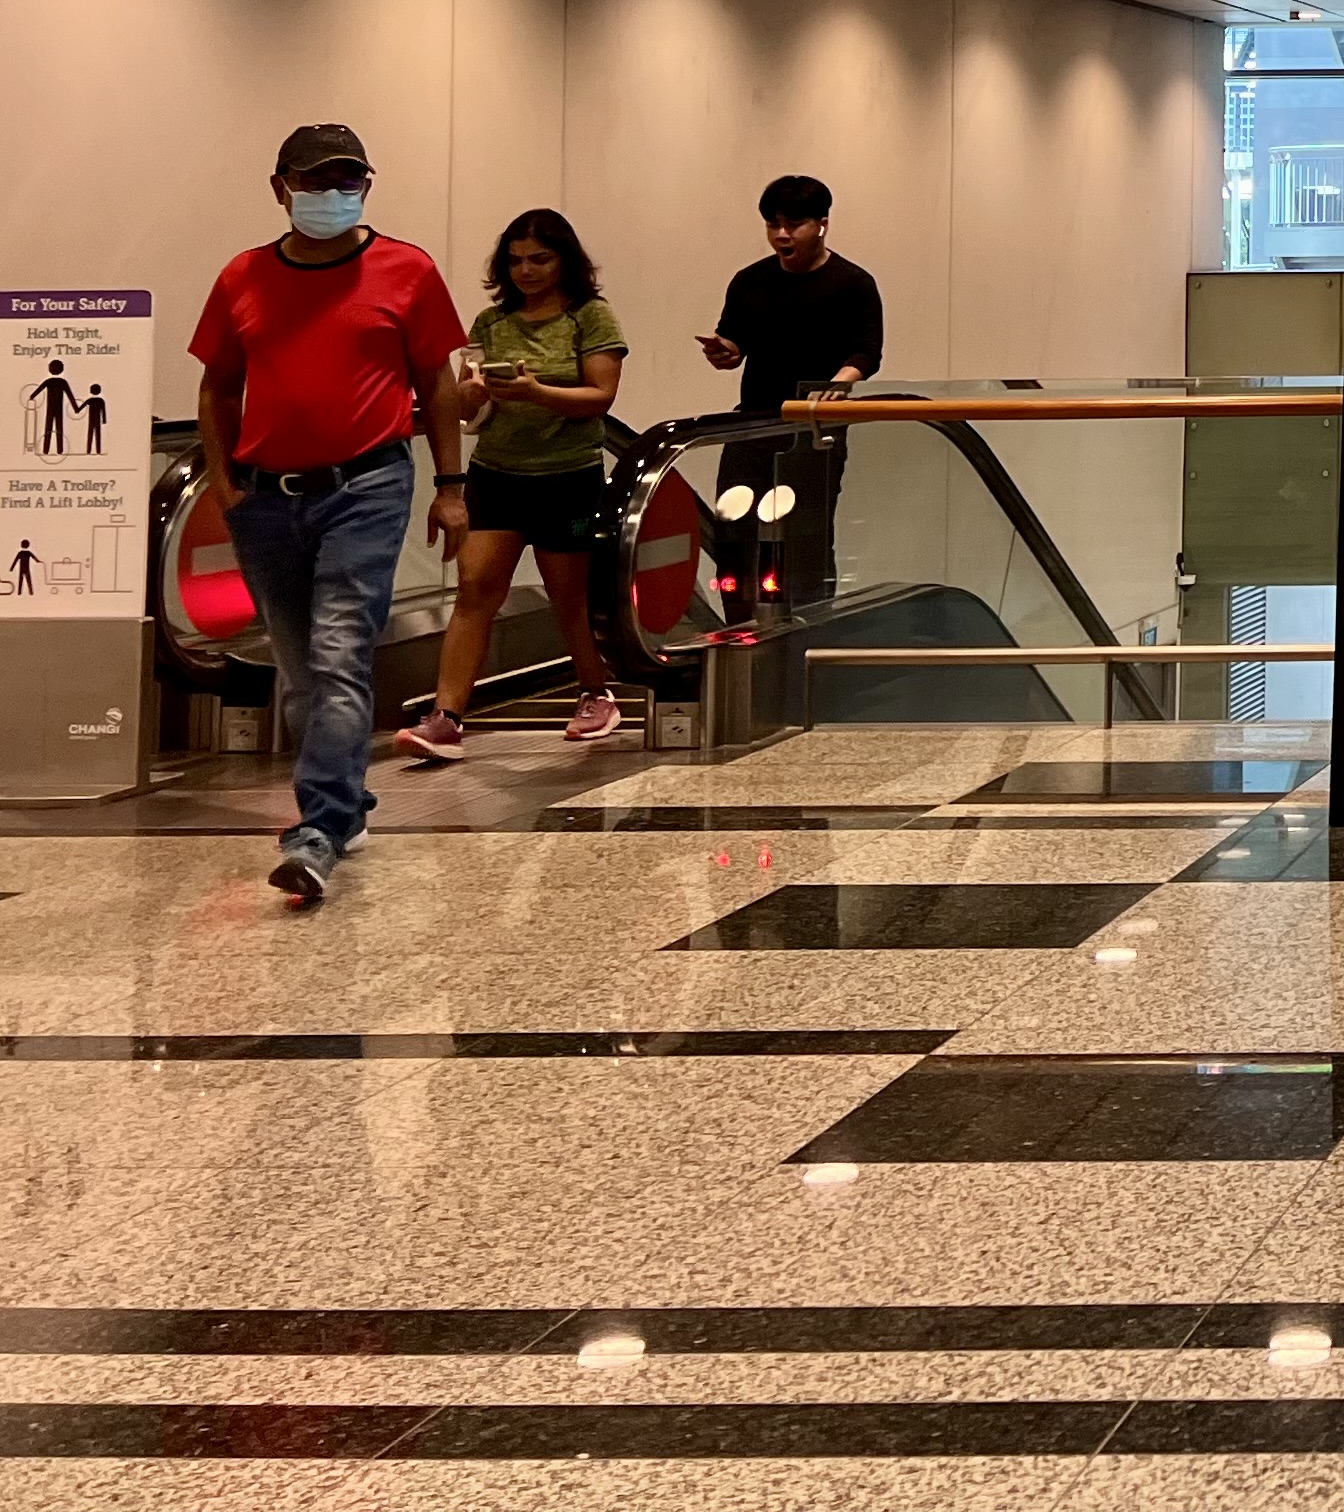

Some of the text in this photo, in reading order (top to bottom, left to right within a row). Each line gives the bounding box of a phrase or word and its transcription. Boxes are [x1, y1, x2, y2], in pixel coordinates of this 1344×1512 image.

[11, 297, 127, 313] For Your Safety
[27, 327, 103, 342] Hold Tight,
[13, 343, 120, 358] Enjoy The Ride!
[8, 479, 116, 494] Have A Trolley?
[0, 496, 123, 510] Find A Lift Lobby!
[68, 724, 120, 734] CHANGI
